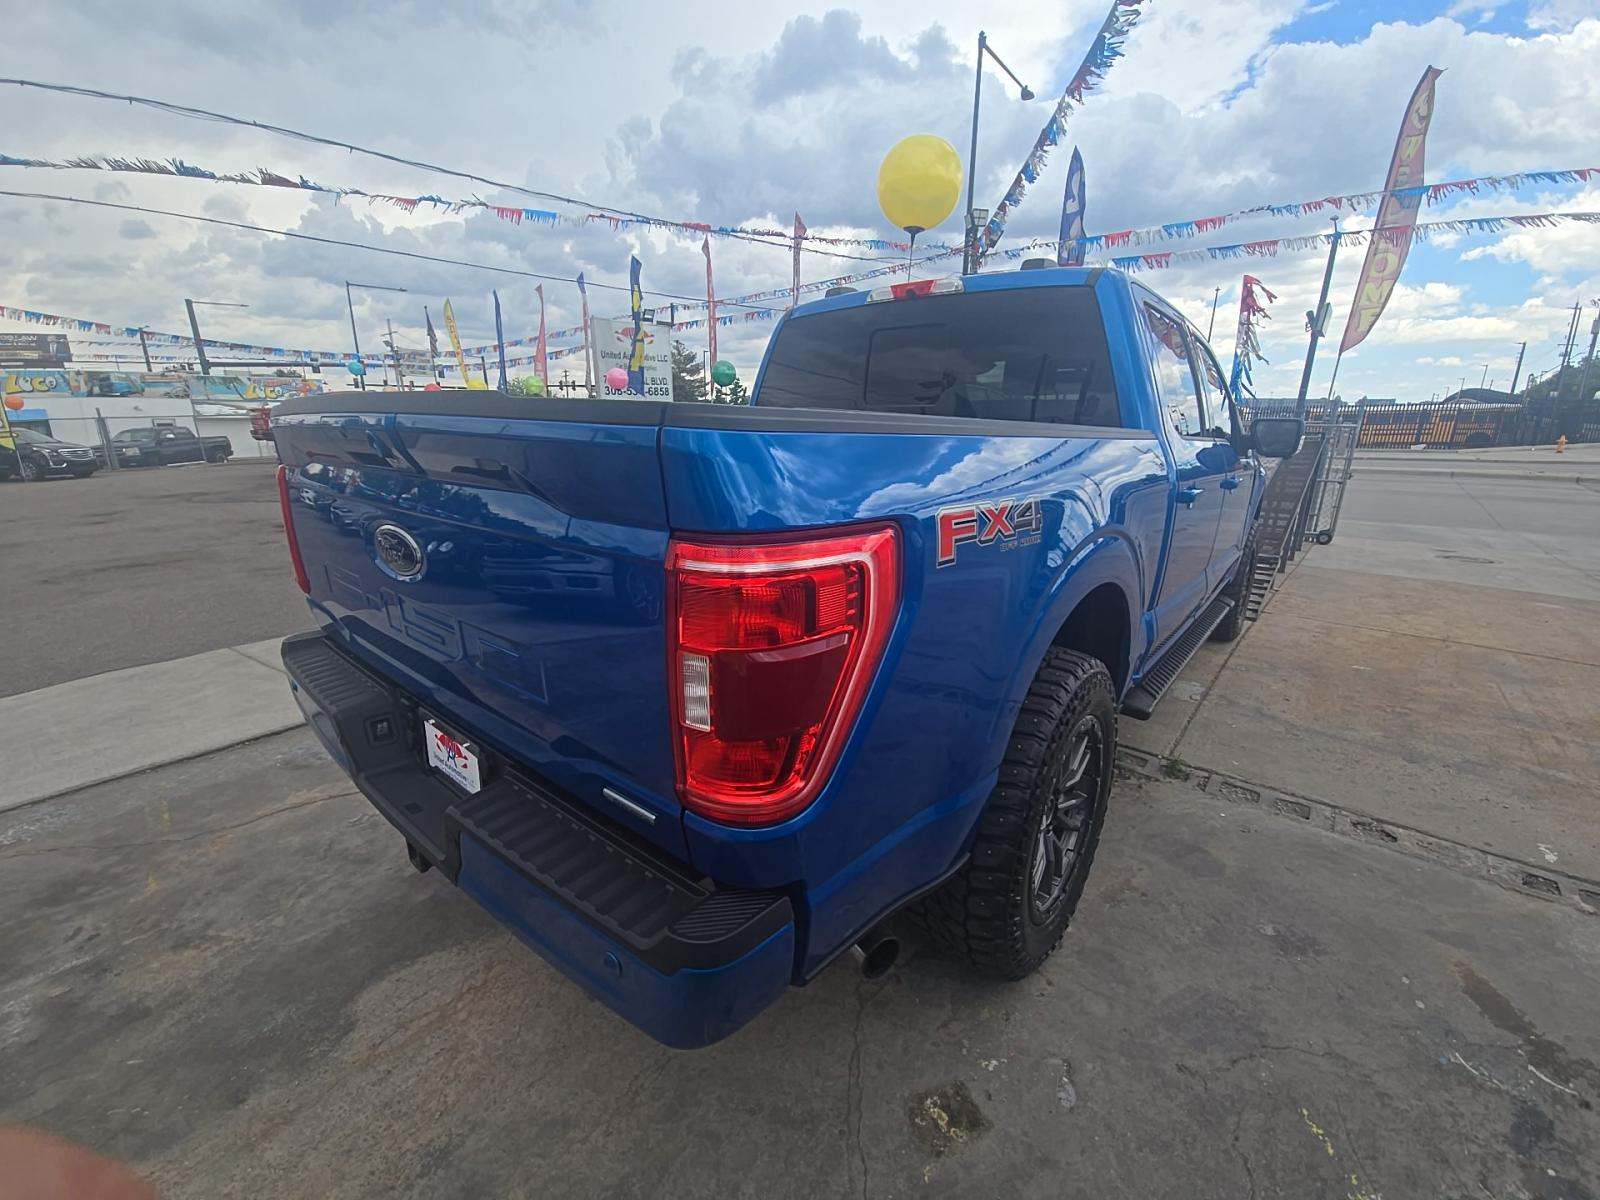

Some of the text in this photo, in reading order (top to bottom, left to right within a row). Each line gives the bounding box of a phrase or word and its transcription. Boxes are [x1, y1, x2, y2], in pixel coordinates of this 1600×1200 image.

[600, 350, 622, 360] United
[657, 354, 668, 363] LLC
[650, 376, 668, 386] BLVD
[935, 494, 1042, 569] FX4
